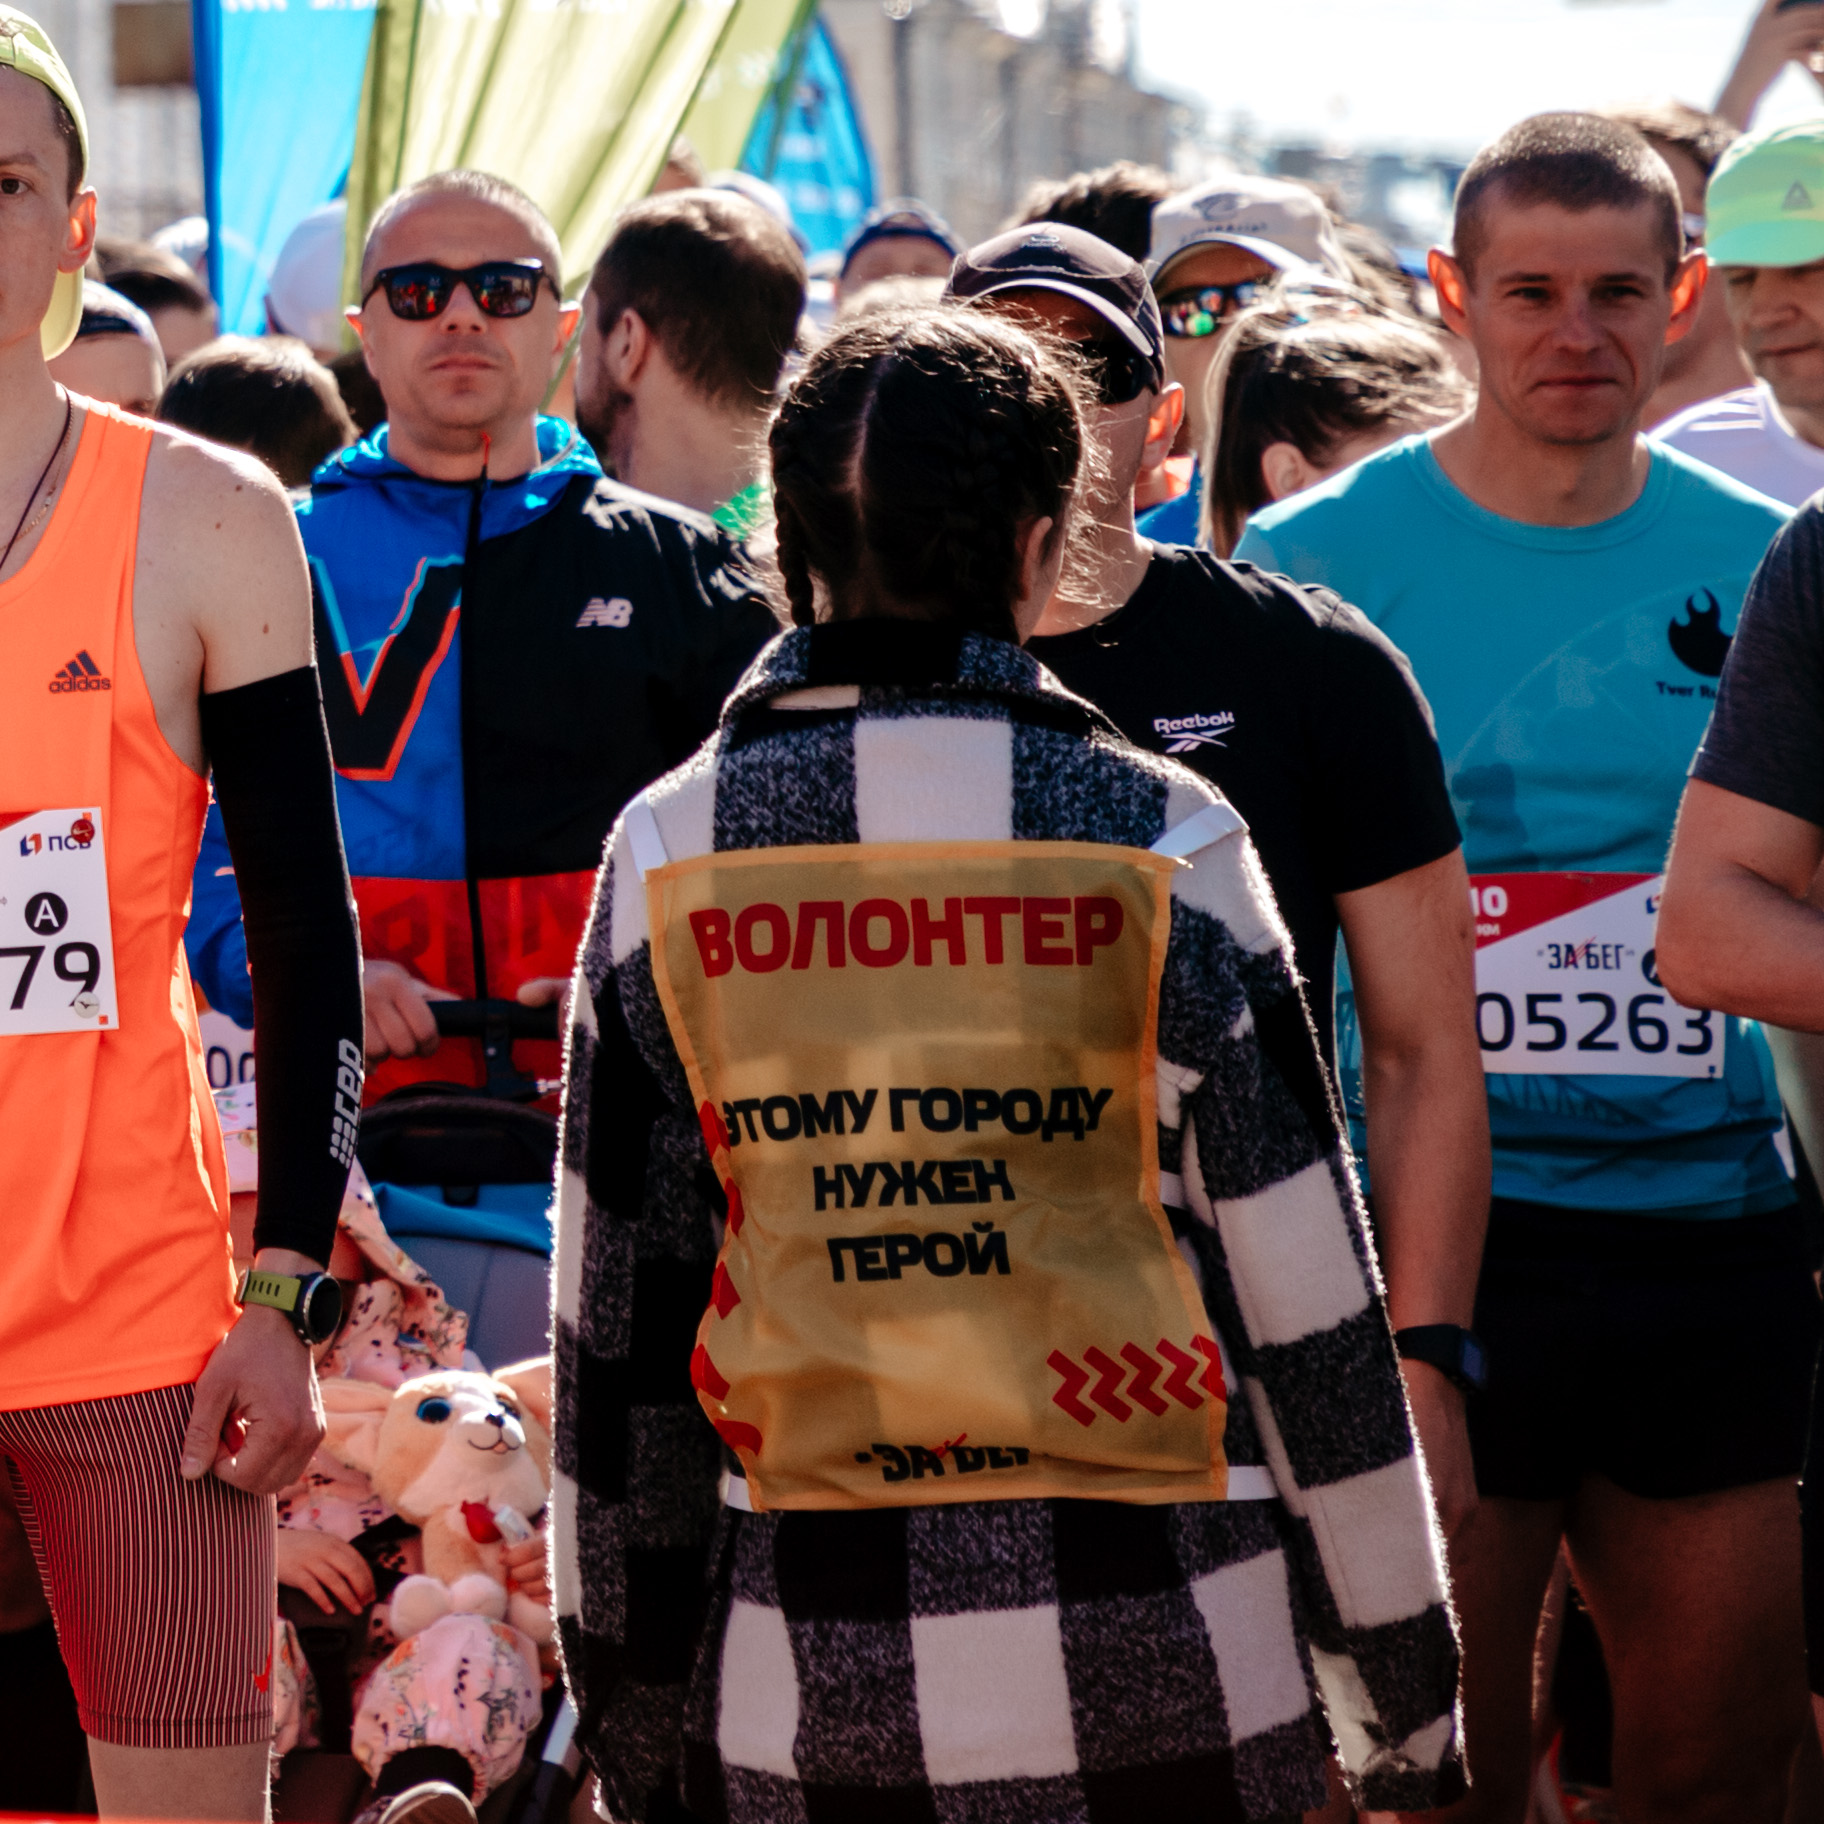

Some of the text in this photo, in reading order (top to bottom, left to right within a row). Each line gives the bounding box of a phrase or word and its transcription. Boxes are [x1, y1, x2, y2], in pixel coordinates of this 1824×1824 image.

[48, 675, 112, 694] adidas
[1153, 711, 1235, 734] Reebok
[33, 898, 60, 928] А
[1469, 886, 1508, 918] 10
[689, 896, 1124, 978] ВОЛОНТЕР
[1476, 992, 1713, 1055] 05263
[888, 1086, 1114, 1143] ГОРОДУ
[812, 1159, 1016, 1211] НУЖЕН
[826, 1221, 1012, 1283] ГЕРОЙ
